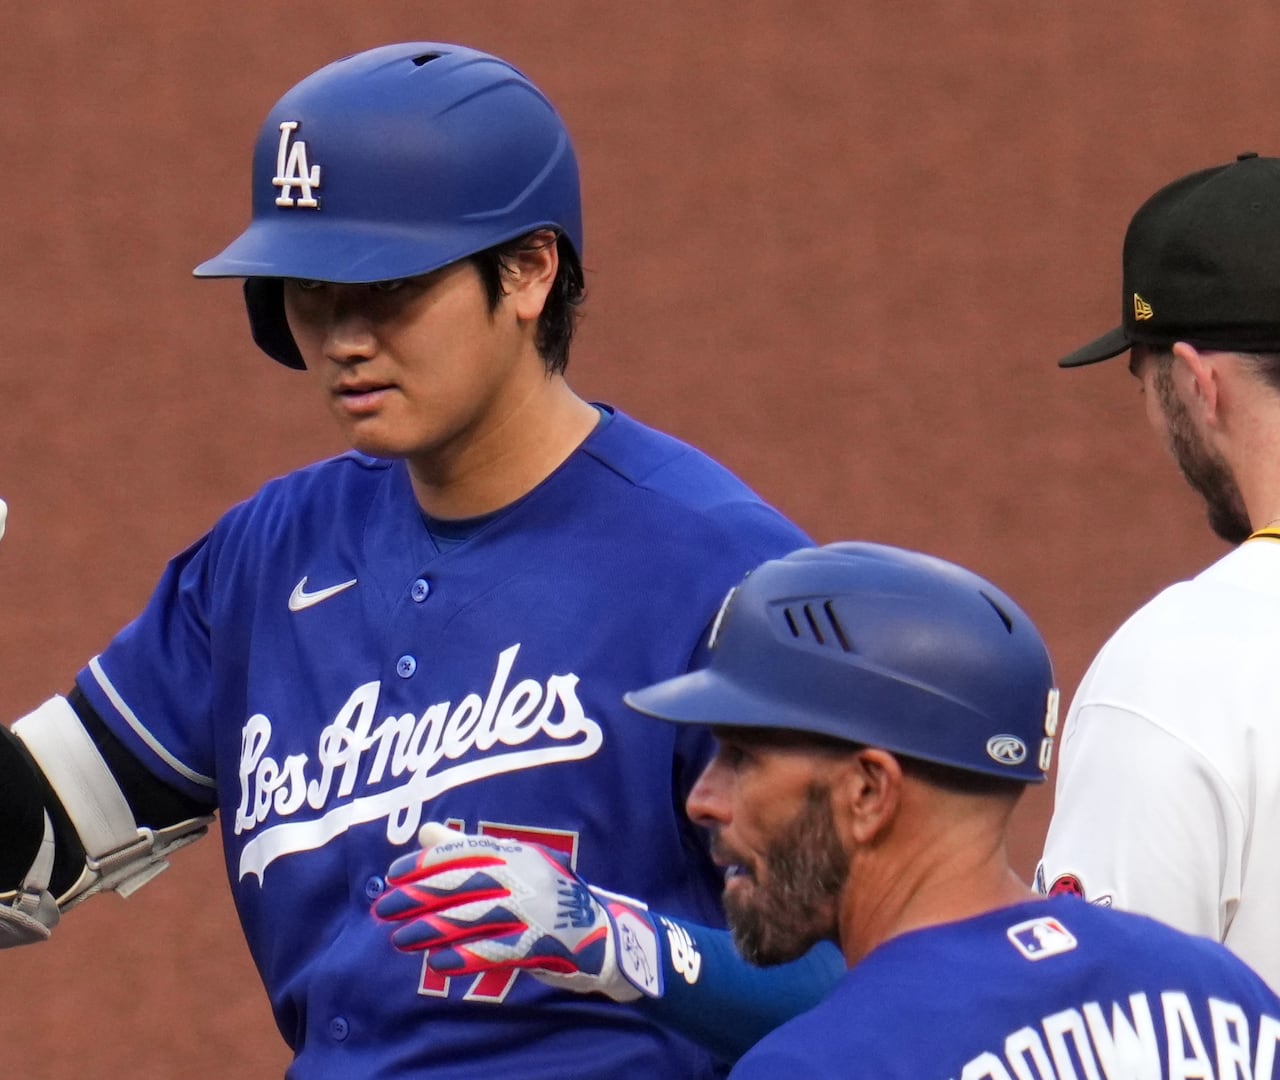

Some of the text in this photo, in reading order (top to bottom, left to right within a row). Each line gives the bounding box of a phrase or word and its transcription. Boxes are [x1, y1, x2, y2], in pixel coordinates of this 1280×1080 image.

[272, 121, 321, 208] LA
[234, 643, 602, 846] Los Angeles
[434, 840, 465, 854] new
